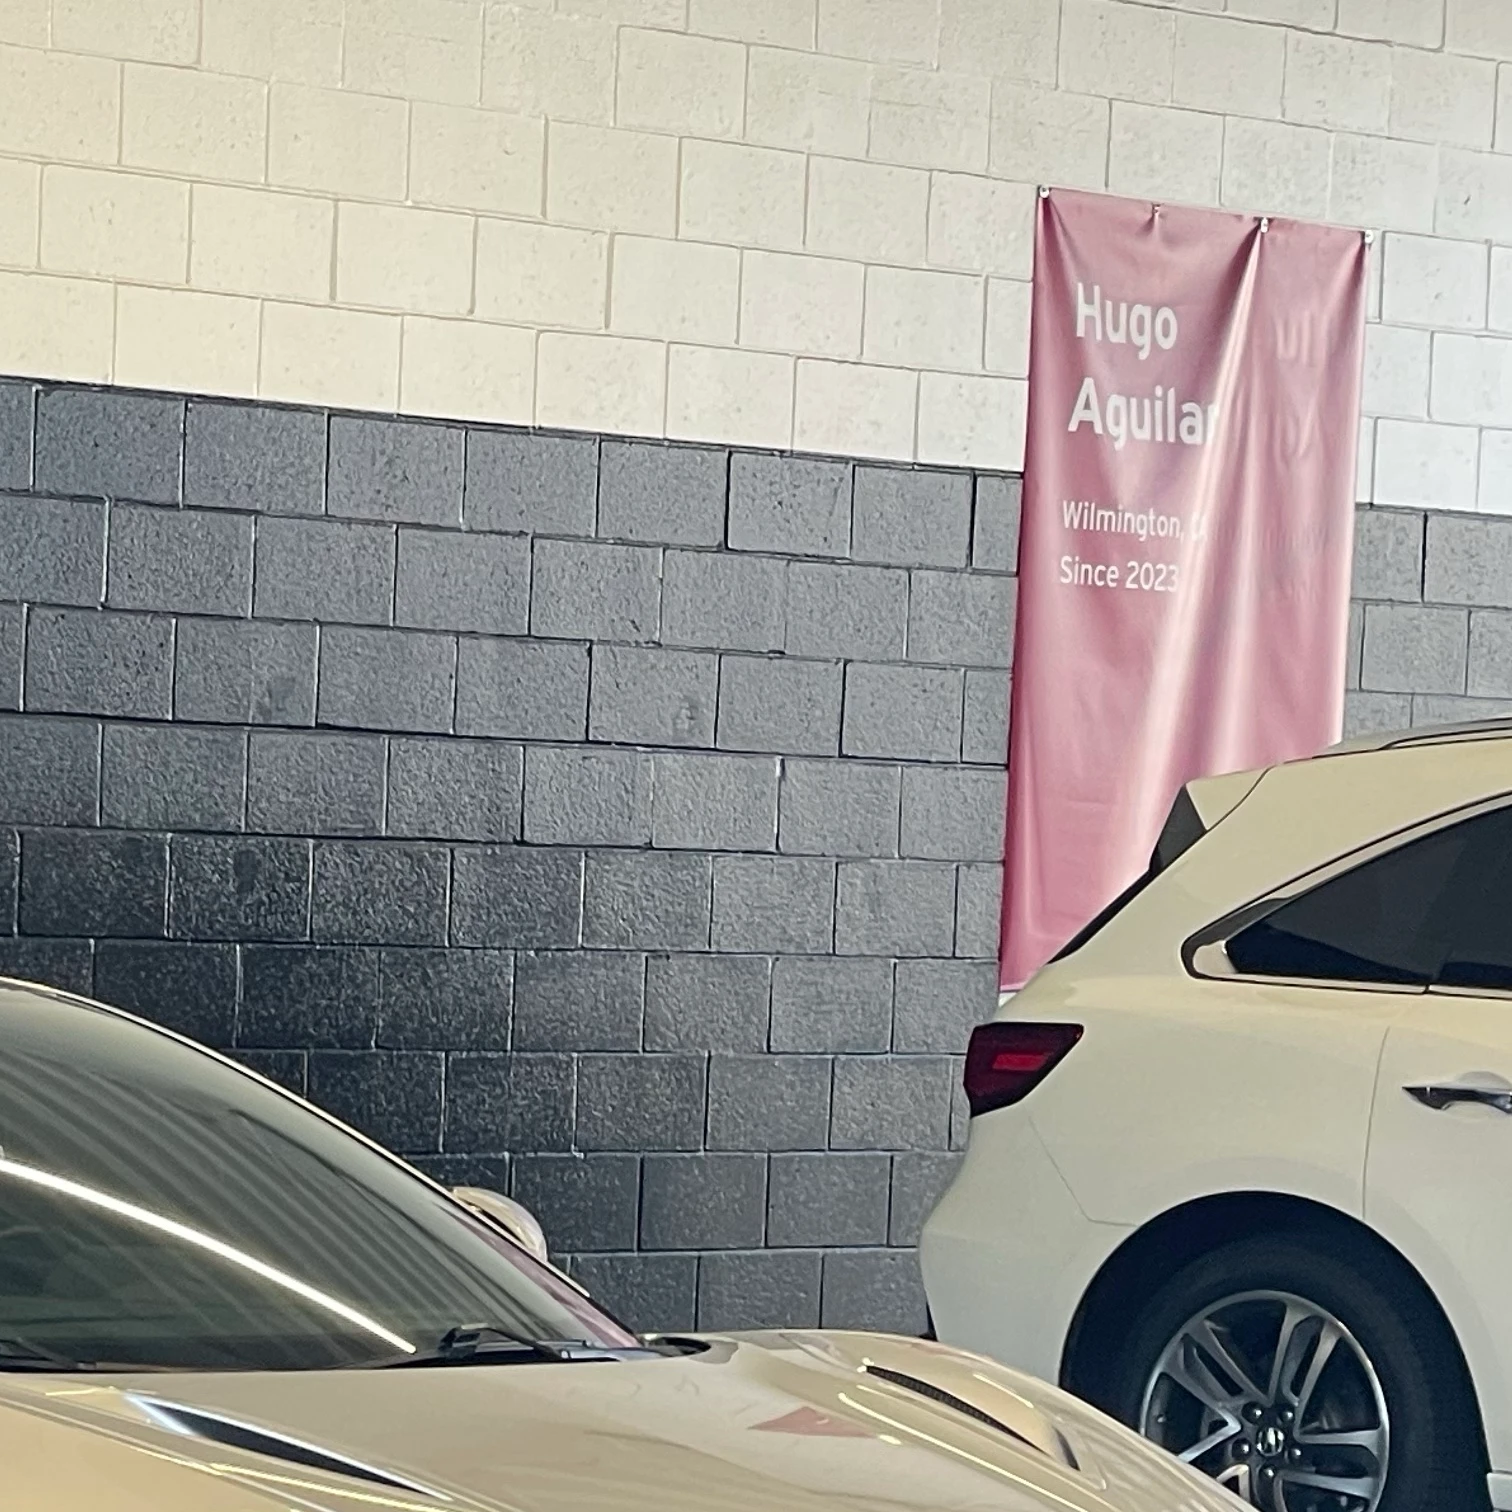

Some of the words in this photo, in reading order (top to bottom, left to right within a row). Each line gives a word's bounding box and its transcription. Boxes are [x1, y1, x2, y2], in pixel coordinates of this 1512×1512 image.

[1075, 282, 1178, 361] Hugo
[1060, 554, 1121, 589] Since
[1124, 560, 1179, 593] 2023
